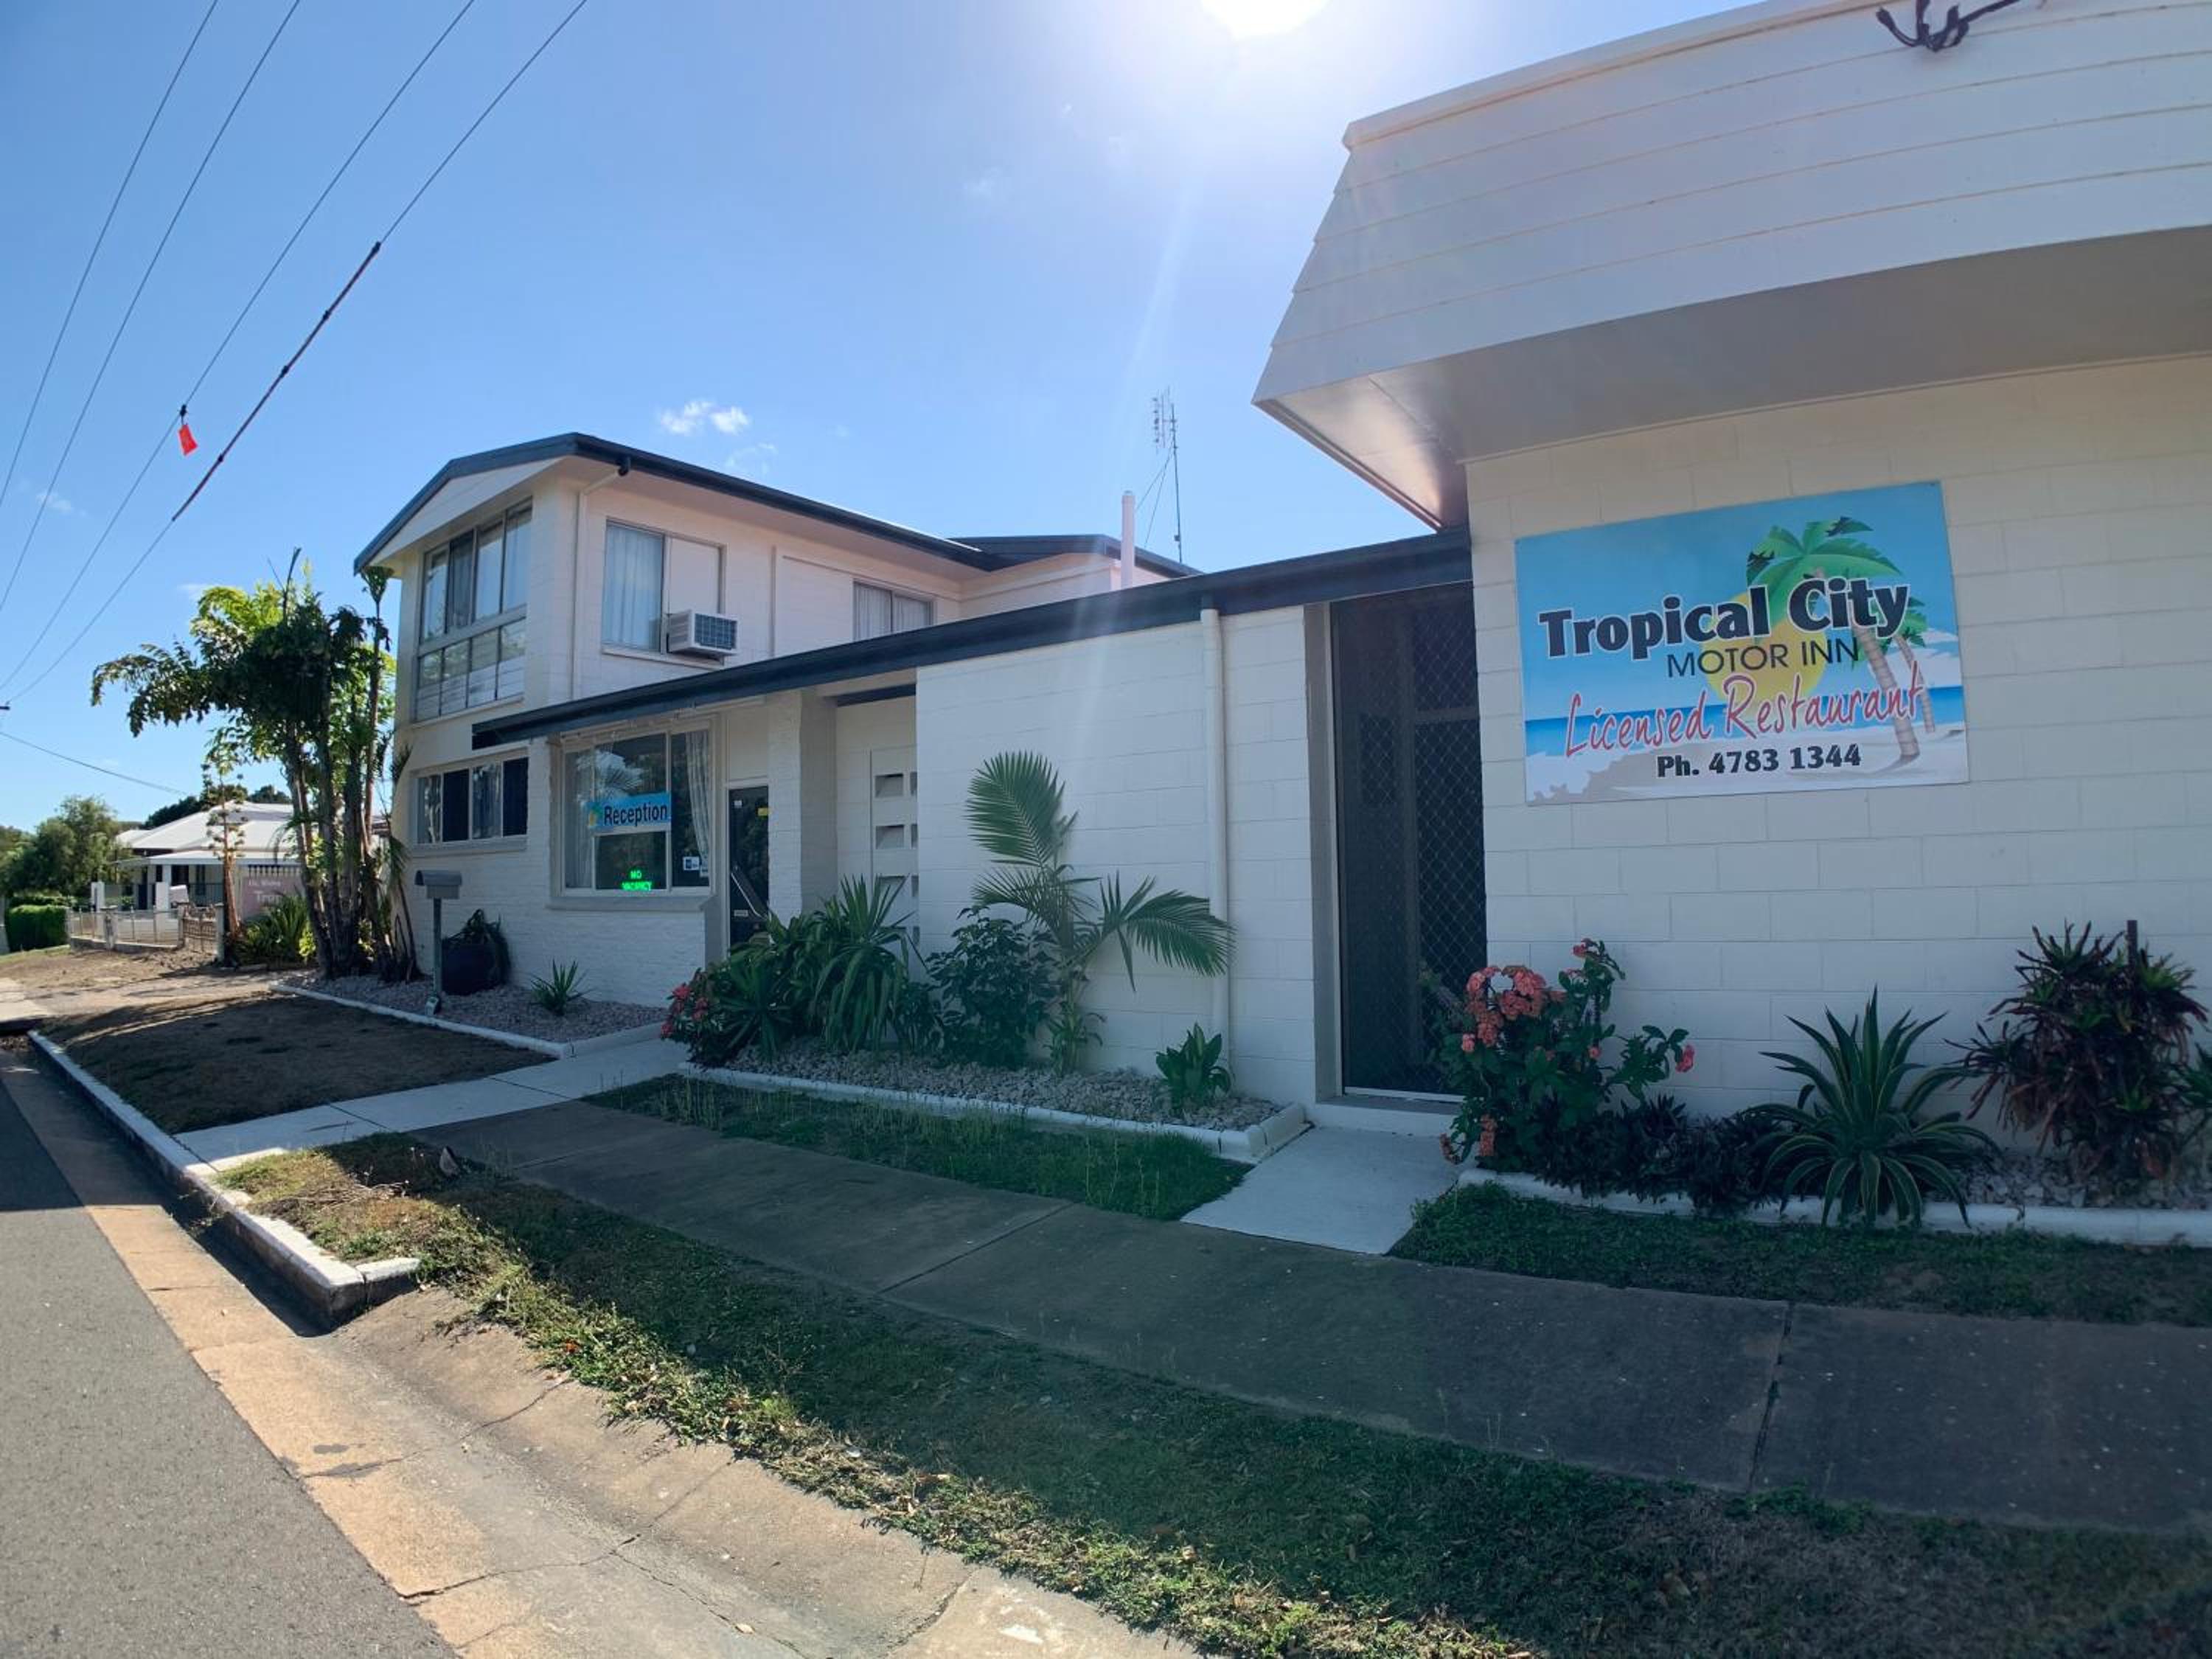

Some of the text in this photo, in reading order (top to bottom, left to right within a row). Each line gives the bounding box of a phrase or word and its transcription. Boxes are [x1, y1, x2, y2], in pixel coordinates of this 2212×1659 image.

[1540, 576, 1910, 660] Tropical City
[1668, 637, 1859, 678] MOTOR INN
[1566, 661, 1924, 757] Licensed Restaurant
[1658, 744, 1861, 777] Ph. 4783 1344
[604, 802, 667, 827] Reception
